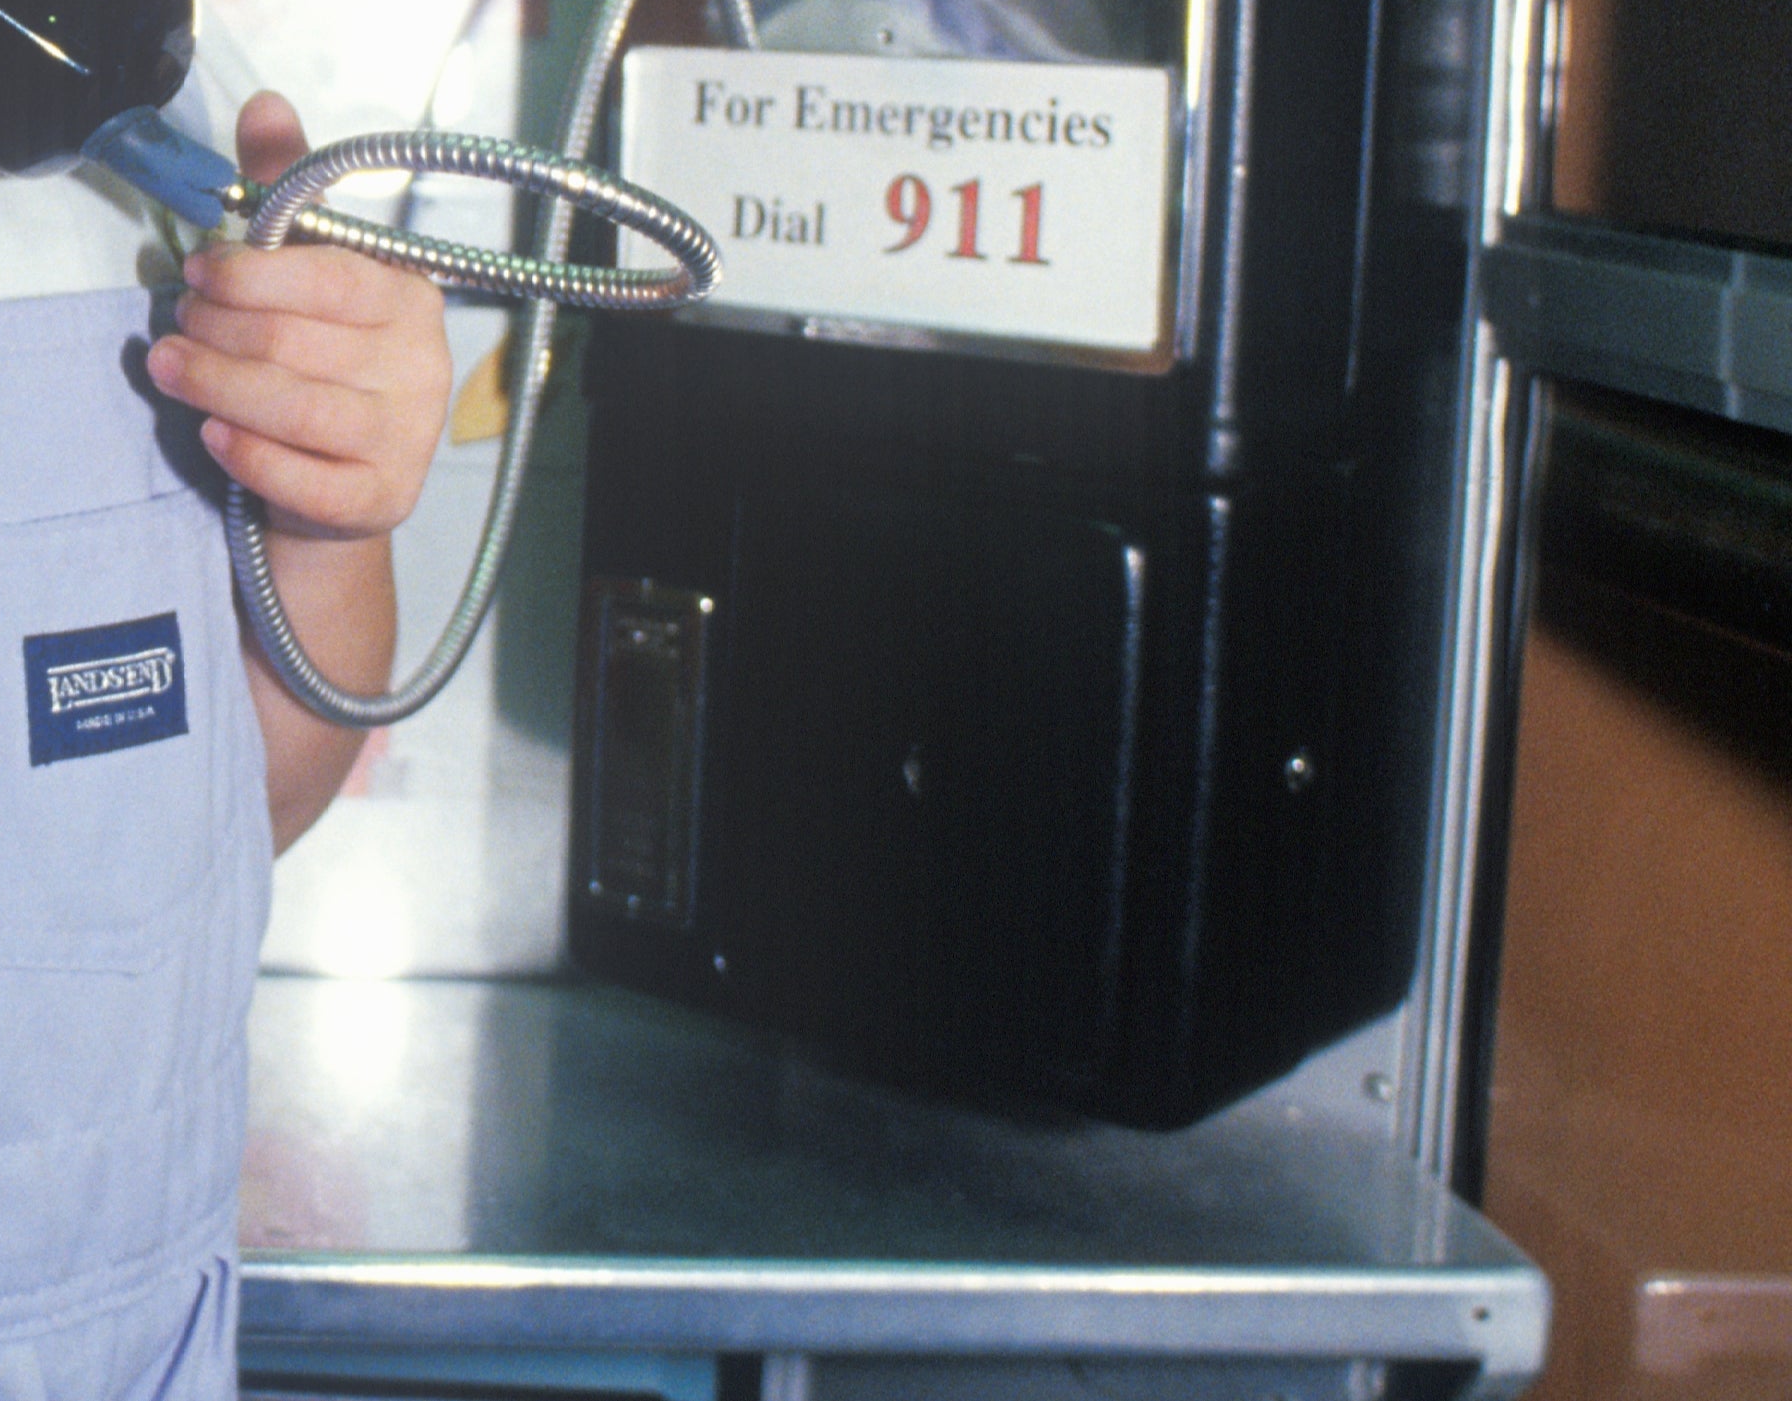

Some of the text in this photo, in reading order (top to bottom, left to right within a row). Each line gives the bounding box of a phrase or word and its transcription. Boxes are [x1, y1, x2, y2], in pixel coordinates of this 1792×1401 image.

[694, 79, 1112, 149] For Emergencies
[730, 171, 1051, 266] Dial 911
